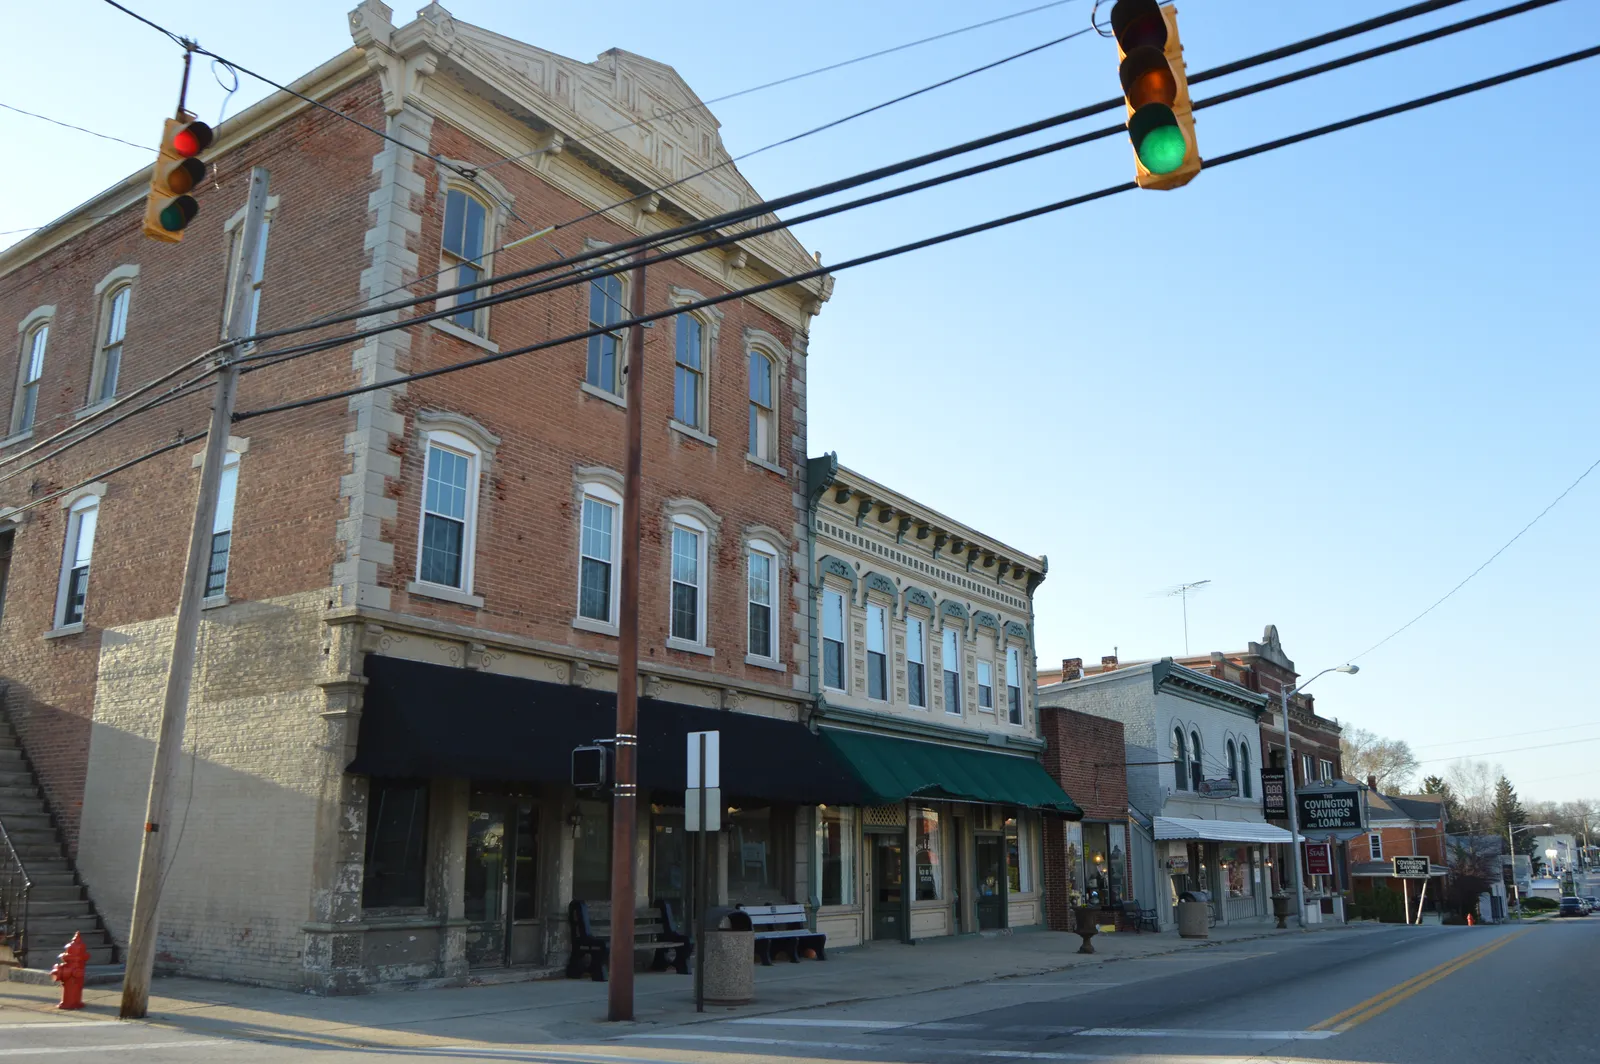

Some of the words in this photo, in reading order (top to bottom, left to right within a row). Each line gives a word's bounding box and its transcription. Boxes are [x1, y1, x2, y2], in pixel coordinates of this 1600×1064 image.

[1304, 799, 1353, 809] COVINGTON
[1310, 808, 1350, 818] SAVINGS
[1318, 818, 1341, 827] LOAN
